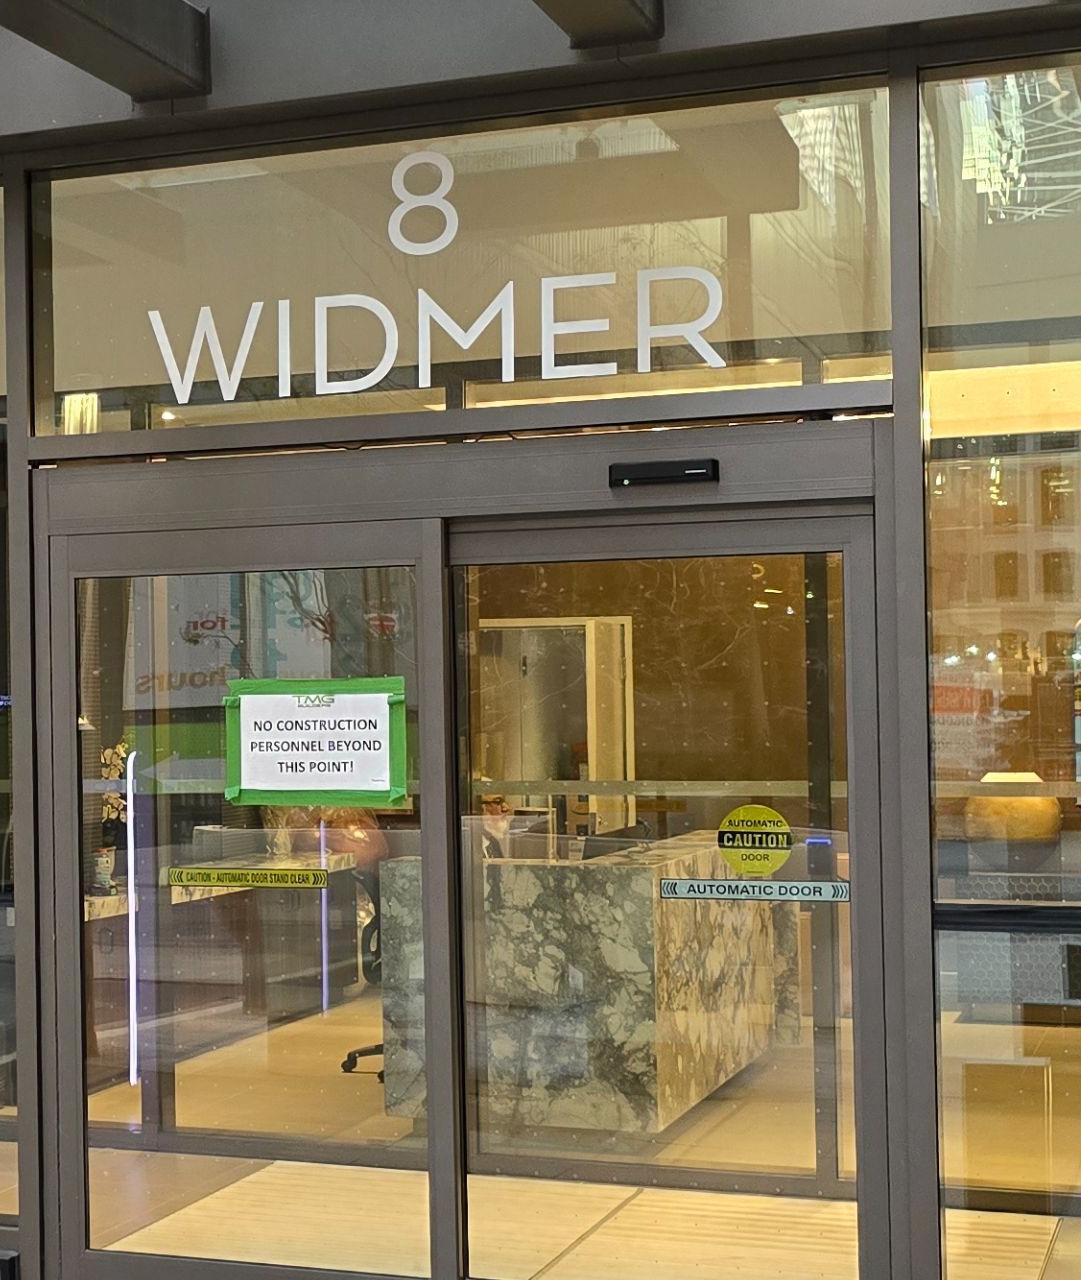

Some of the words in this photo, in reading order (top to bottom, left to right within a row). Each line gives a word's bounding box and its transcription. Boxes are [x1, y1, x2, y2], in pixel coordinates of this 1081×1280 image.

[387, 150, 459, 256] 8
[147, 265, 727, 405] WIDMER
[292, 694, 336, 704] TMG
[253, 720, 273, 732] NO
[276, 719, 378, 732] CONSTRUCTION
[250, 740, 324, 752] PERSONNEL
[328, 740, 382, 752] BEYOND
[277, 761, 306, 773] THIS
[309, 760, 354, 773] POINT!
[727, 819, 783, 828] AUTOMATIC
[723, 832, 788, 848] CAUTION
[740, 853, 770, 862] DOOR
[185, 872, 212, 882] CAUTION
[216, 872, 250, 883] AUTOMATIC
[250, 873, 268, 883] DOOR
[269, 873, 289, 884] STAND
[289, 874, 311, 884] CLEAR
[686, 883, 774, 896] AUTOMATIC
[778, 885, 823, 896] DOOR
